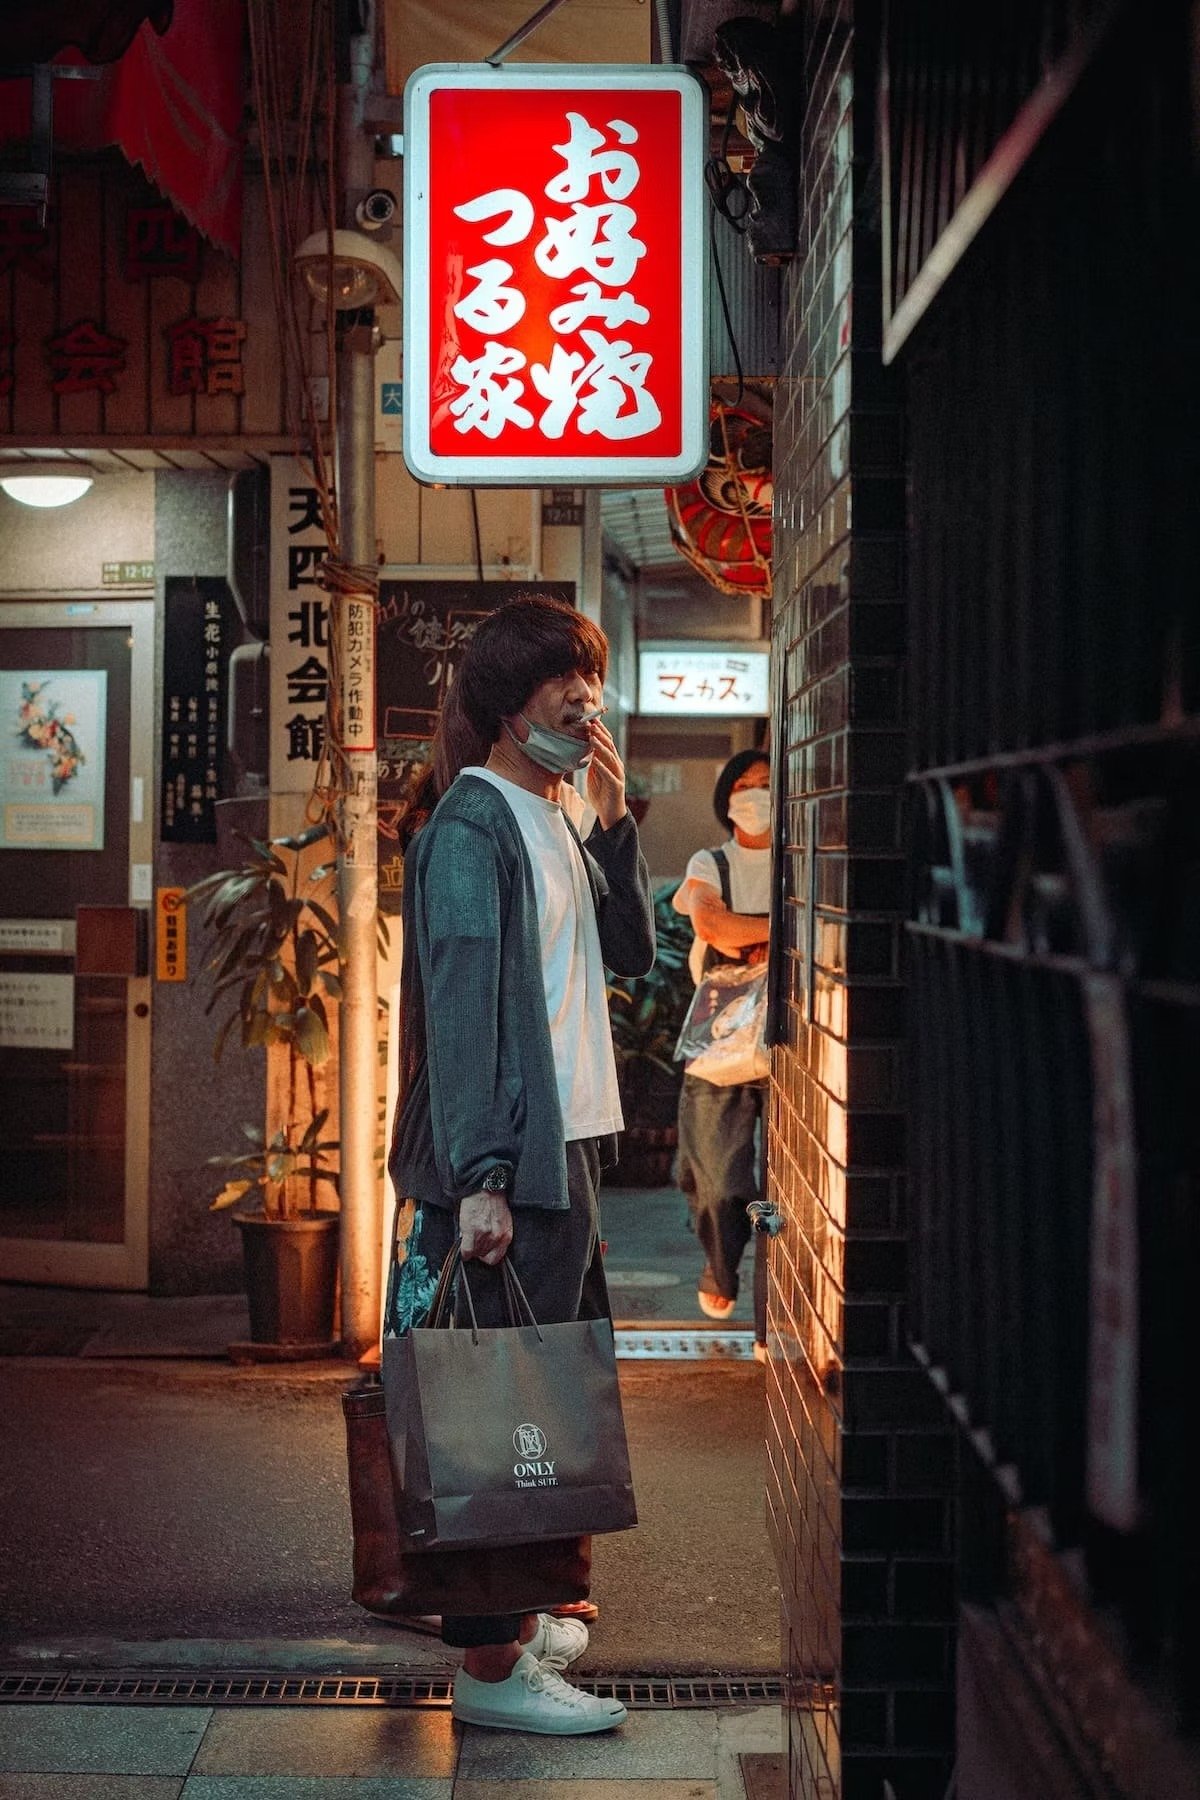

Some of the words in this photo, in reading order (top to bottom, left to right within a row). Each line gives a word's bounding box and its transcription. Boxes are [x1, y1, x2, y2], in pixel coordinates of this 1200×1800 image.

[450, 188, 536, 440] つる家
[531, 112, 663, 441] お好み焼
[347, 604, 364, 738] 防犯カメラ作動中
[513, 1461, 555, 1478] ONLY
[515, 1479, 537, 1489] Think
